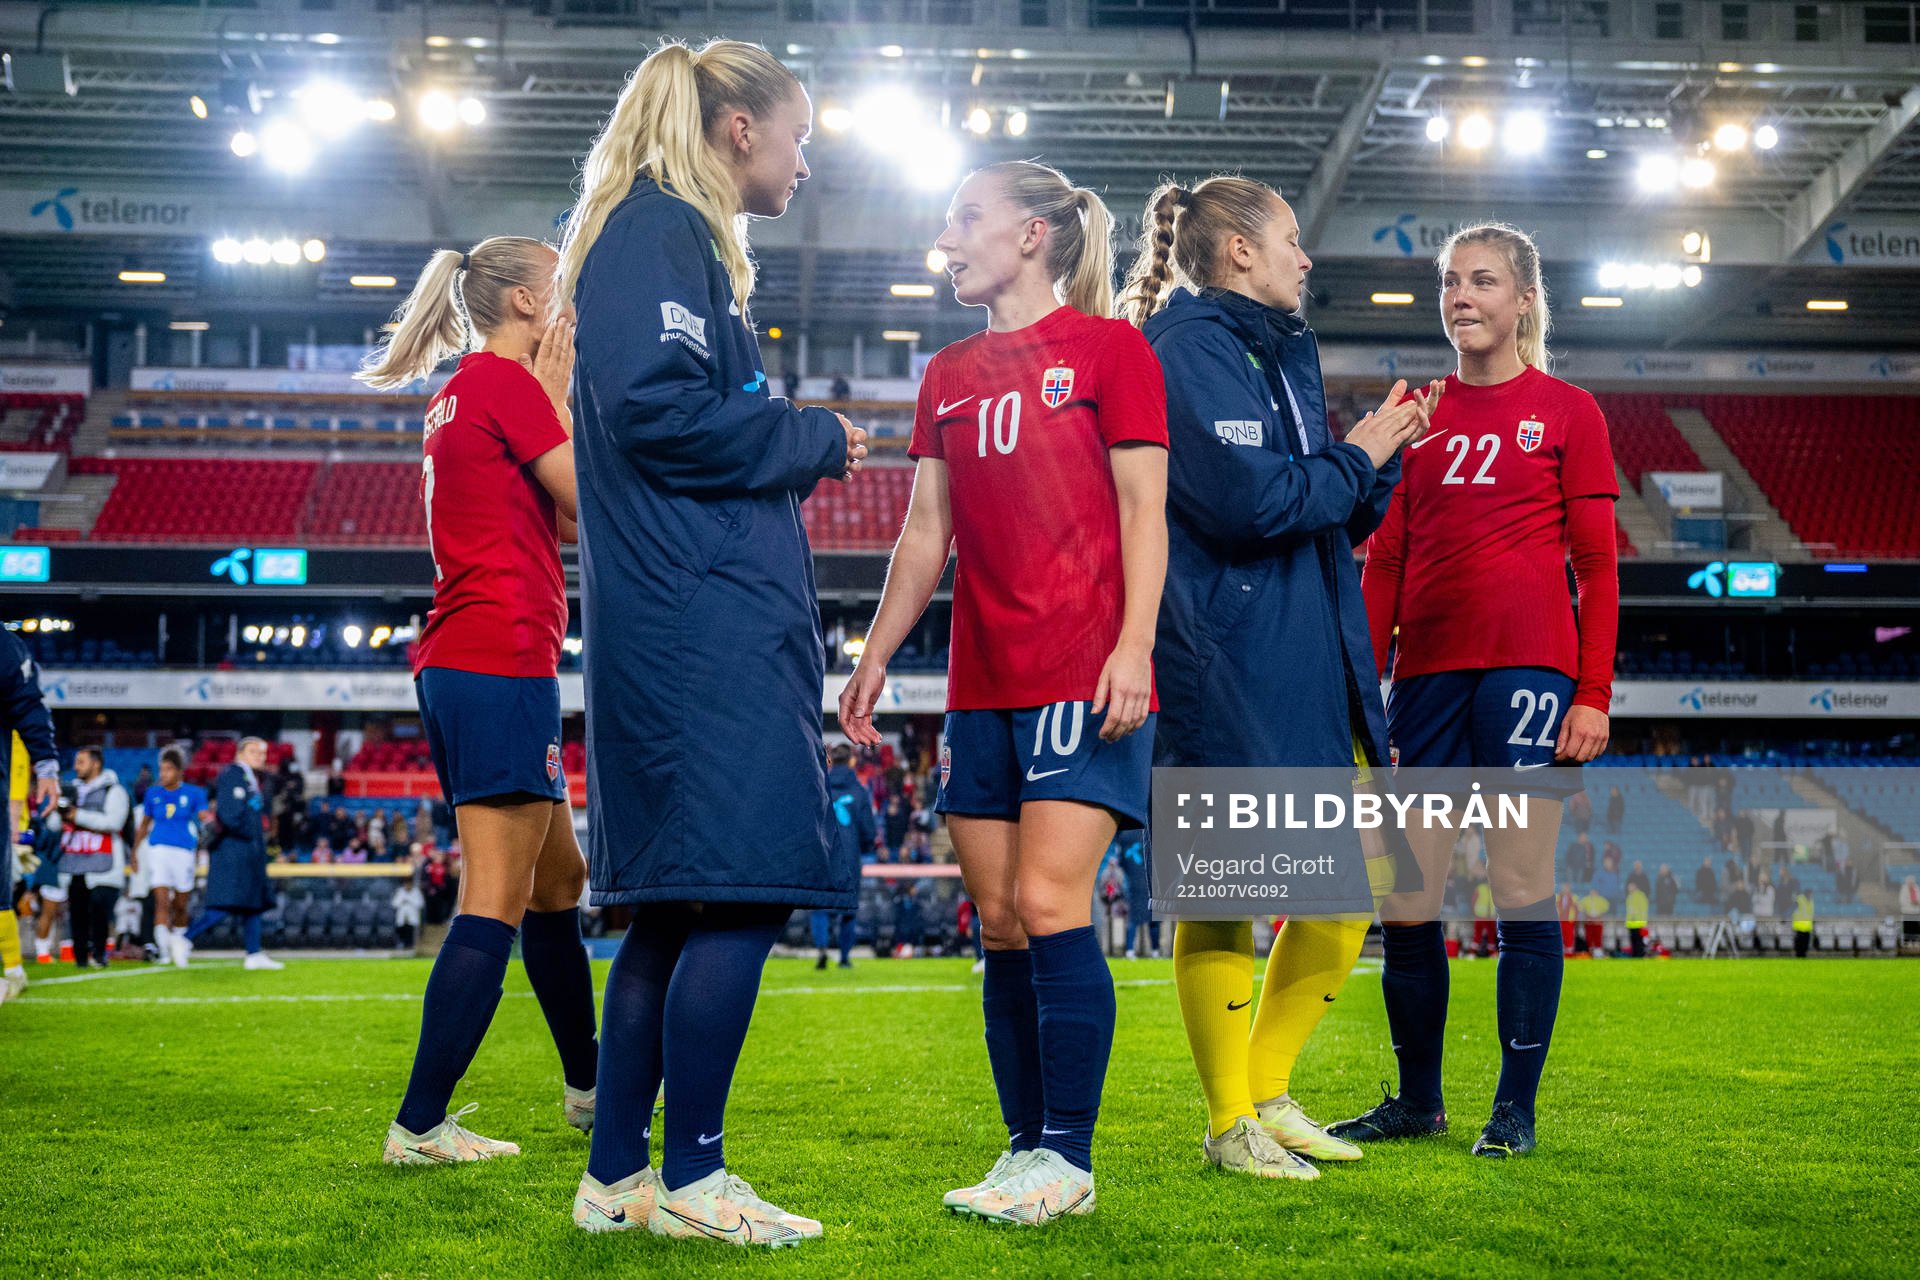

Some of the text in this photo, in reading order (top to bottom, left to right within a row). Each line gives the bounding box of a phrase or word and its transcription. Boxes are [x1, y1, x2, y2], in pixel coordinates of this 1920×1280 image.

[81, 198, 191, 225] telenor
[1849, 230, 1920, 257] telen
[670, 307, 702, 337] DNB
[978, 390, 1021, 458] 10
[1222, 420, 1259, 445] DNB
[1441, 433, 1502, 485] 22
[1702, 690, 1758, 708] telenor
[1833, 690, 1889, 709] telenor
[1033, 700, 1084, 757] 10
[1507, 688, 1559, 748] 22
